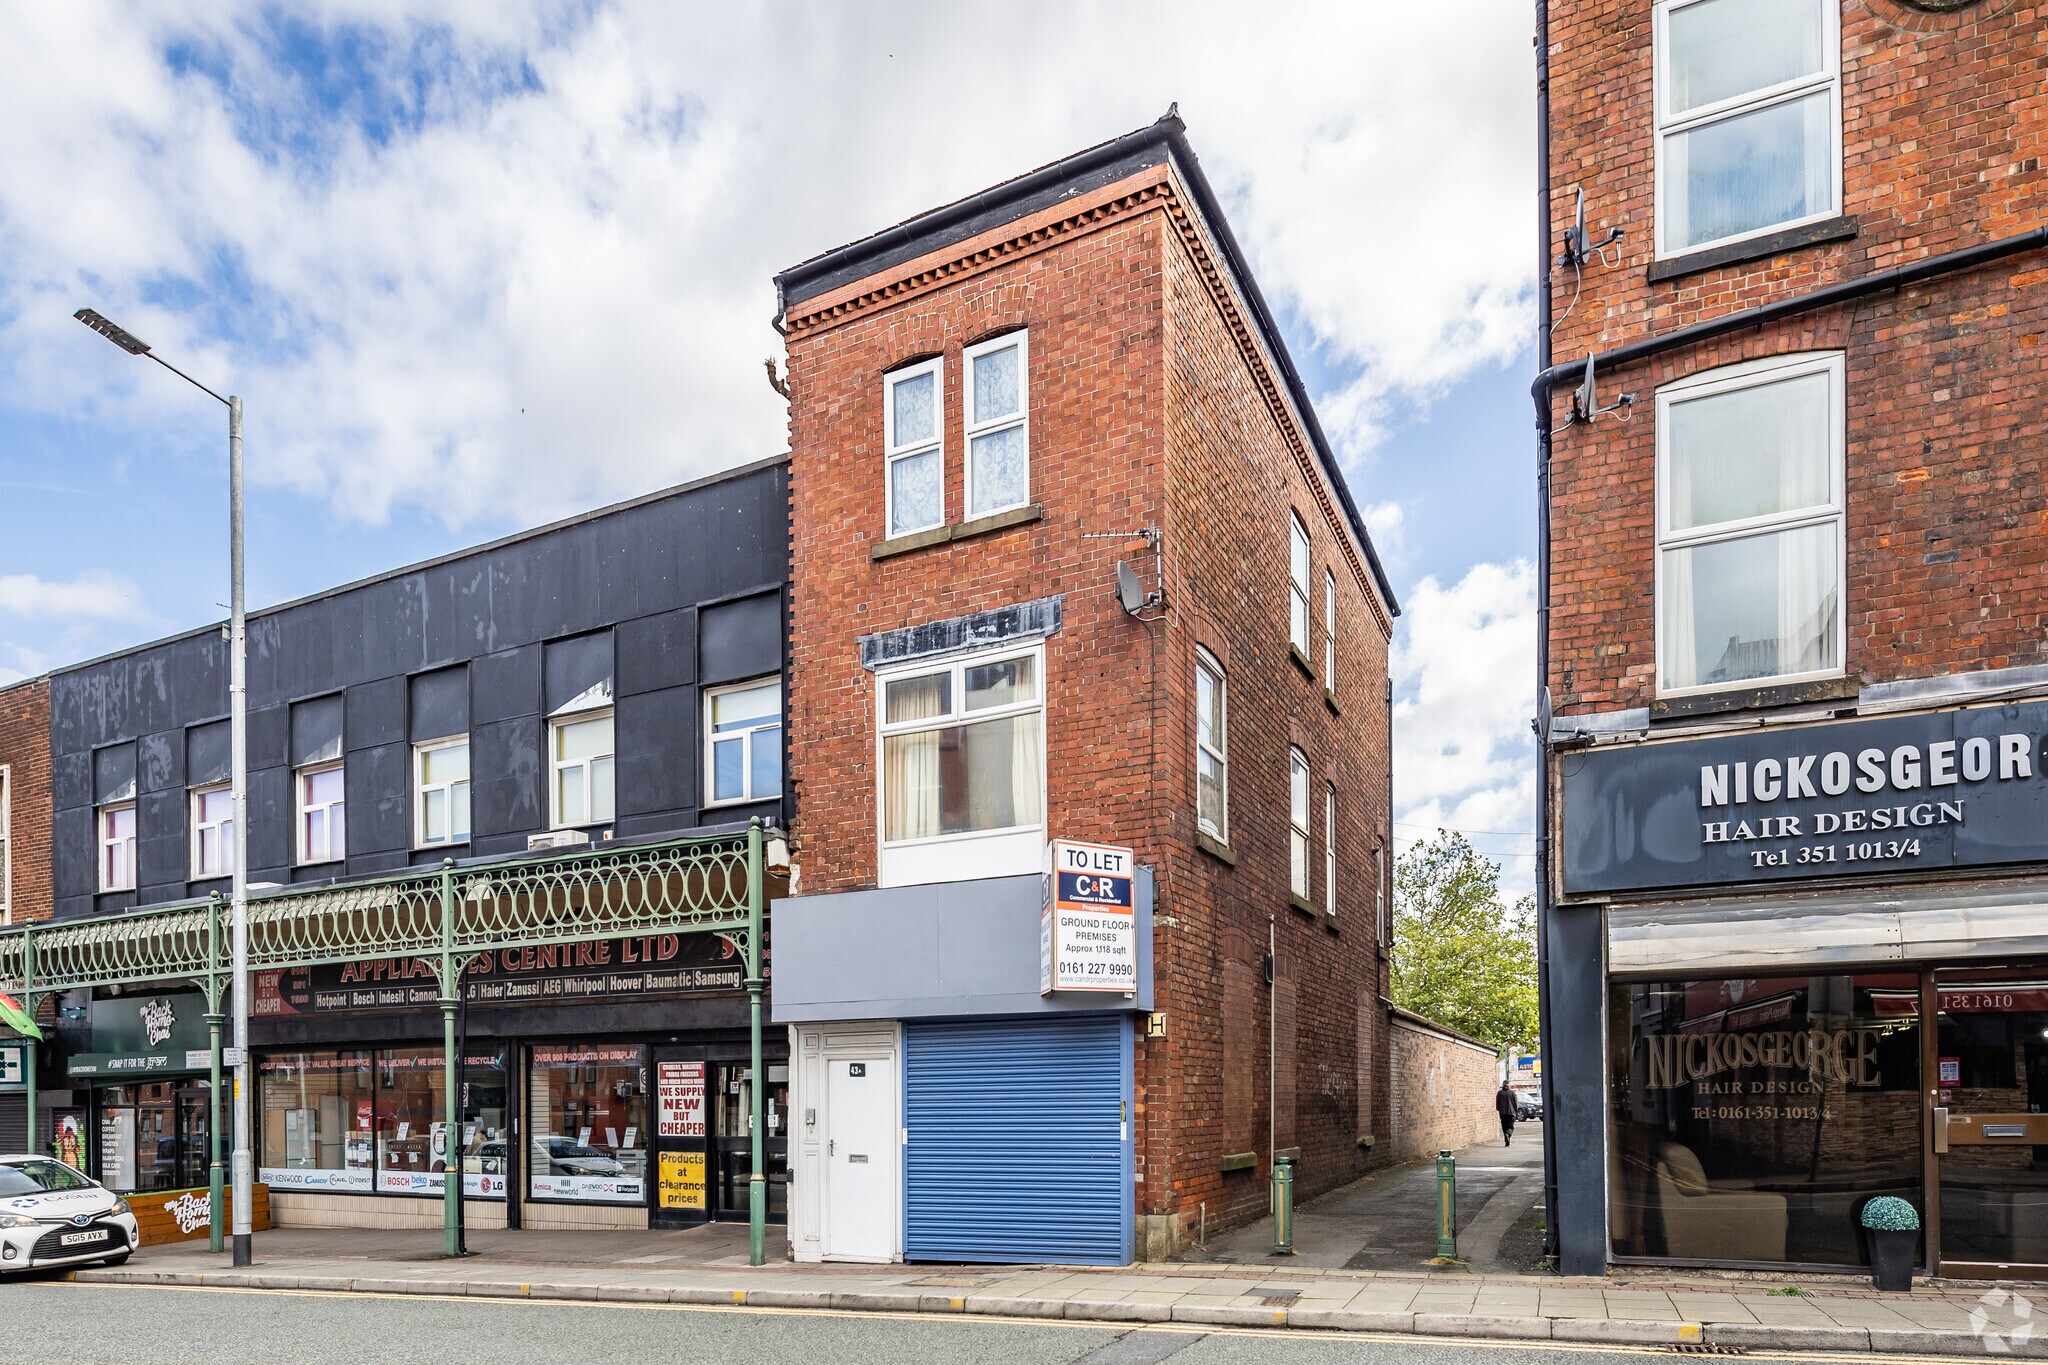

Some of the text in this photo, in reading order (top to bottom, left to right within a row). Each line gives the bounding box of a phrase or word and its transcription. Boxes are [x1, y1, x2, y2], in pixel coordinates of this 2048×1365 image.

[1700, 733, 2033, 808] NICKOSGEOR
[1702, 799, 1965, 844] HAIR DESIGN
[1750, 837, 1921, 868] Tel 351 1013/4
[1066, 848, 1123, 872] TO LET
[1076, 875, 1114, 898] C&R
[1069, 894, 1095, 902] Commercial
[1081, 904, 1110, 912] Properties
[1060, 917, 1100, 928] GROUND
[1102, 920, 1130, 930] FLOOR
[1075, 931, 1117, 942] PREMISES
[1065, 943, 1093, 954] Approx
[1112, 946, 1127, 955] sqft
[340, 933, 679, 982] APPLIAES CENTRE LTD
[1059, 961, 1084, 974] 0161
[1088, 962, 1106, 975] 227
[1109, 963, 1133, 976] 9990
[258, 974, 279, 987] NEW
[262, 988, 274, 997] BUT
[316, 993, 347, 1010] Hotpoint
[352, 991, 375, 1005] Bosch
[378, 990, 405, 1004] Indesit
[409, 988, 438, 1002] Cannon
[480, 984, 504, 998] Haier
[506, 981, 540, 996] Zanussi
[543, 980, 561, 995] AEG
[564, 976, 606, 996] Whirlpool
[610, 975, 643, 991] Hoover
[646, 971, 692, 988] Baumatic
[695, 970, 740, 988] Samsung
[149, 999, 173, 1020] Back
[256, 998, 281, 1013] CHEAPER
[1151, 1016, 1163, 1034] H
[150, 1026, 171, 1046] Chai
[378, 1059, 388, 1068] WE
[388, 1059, 410, 1067] DELIVER
[418, 1058, 427, 1066] WE
[427, 1058, 446, 1066] INSTAL
[467, 1056, 495, 1065] RECYCLE
[534, 1053, 552, 1062] OVER
[563, 1051, 598, 1061] PRODUCTS
[598, 1051, 609, 1060] ON
[609, 1050, 638, 1060] DISPLAY
[1645, 1028, 1881, 1090] NICKOSGEORGE
[108, 1059, 123, 1069] #SNAP
[123, 1058, 128, 1068] IT
[128, 1058, 137, 1068] FOR
[138, 1057, 146, 1067] THE
[260, 1062, 276, 1070] GREAT
[330, 1059, 347, 1067] GREAT
[347, 1058, 370, 1067] SERVICE
[659, 1087, 705, 1097] WE SUPPLY
[1697, 1081, 1826, 1095] HAIR DESIGN
[663, 1098, 700, 1110] NEW
[673, 1111, 690, 1121] BUT
[1718, 1105, 1833, 1120] 0161-351-1013/4
[660, 1122, 705, 1135] CHEAPER
[660, 1153, 704, 1164] Products
[275, 1174, 303, 1183] KENWOOD
[677, 1167, 687, 1177] at
[387, 1176, 410, 1186] BOSCH
[411, 1175, 427, 1184] beko
[429, 1179, 446, 1188] ZANUSS
[492, 1181, 503, 1190] LG
[659, 1179, 705, 1190] clearance
[533, 1183, 552, 1191] Amica
[553, 1187, 579, 1196] newworld
[44, 1192, 99, 1202] CoStar
[667, 1193, 698, 1204] prices
[66, 1231, 103, 1244] SG15 AVX
